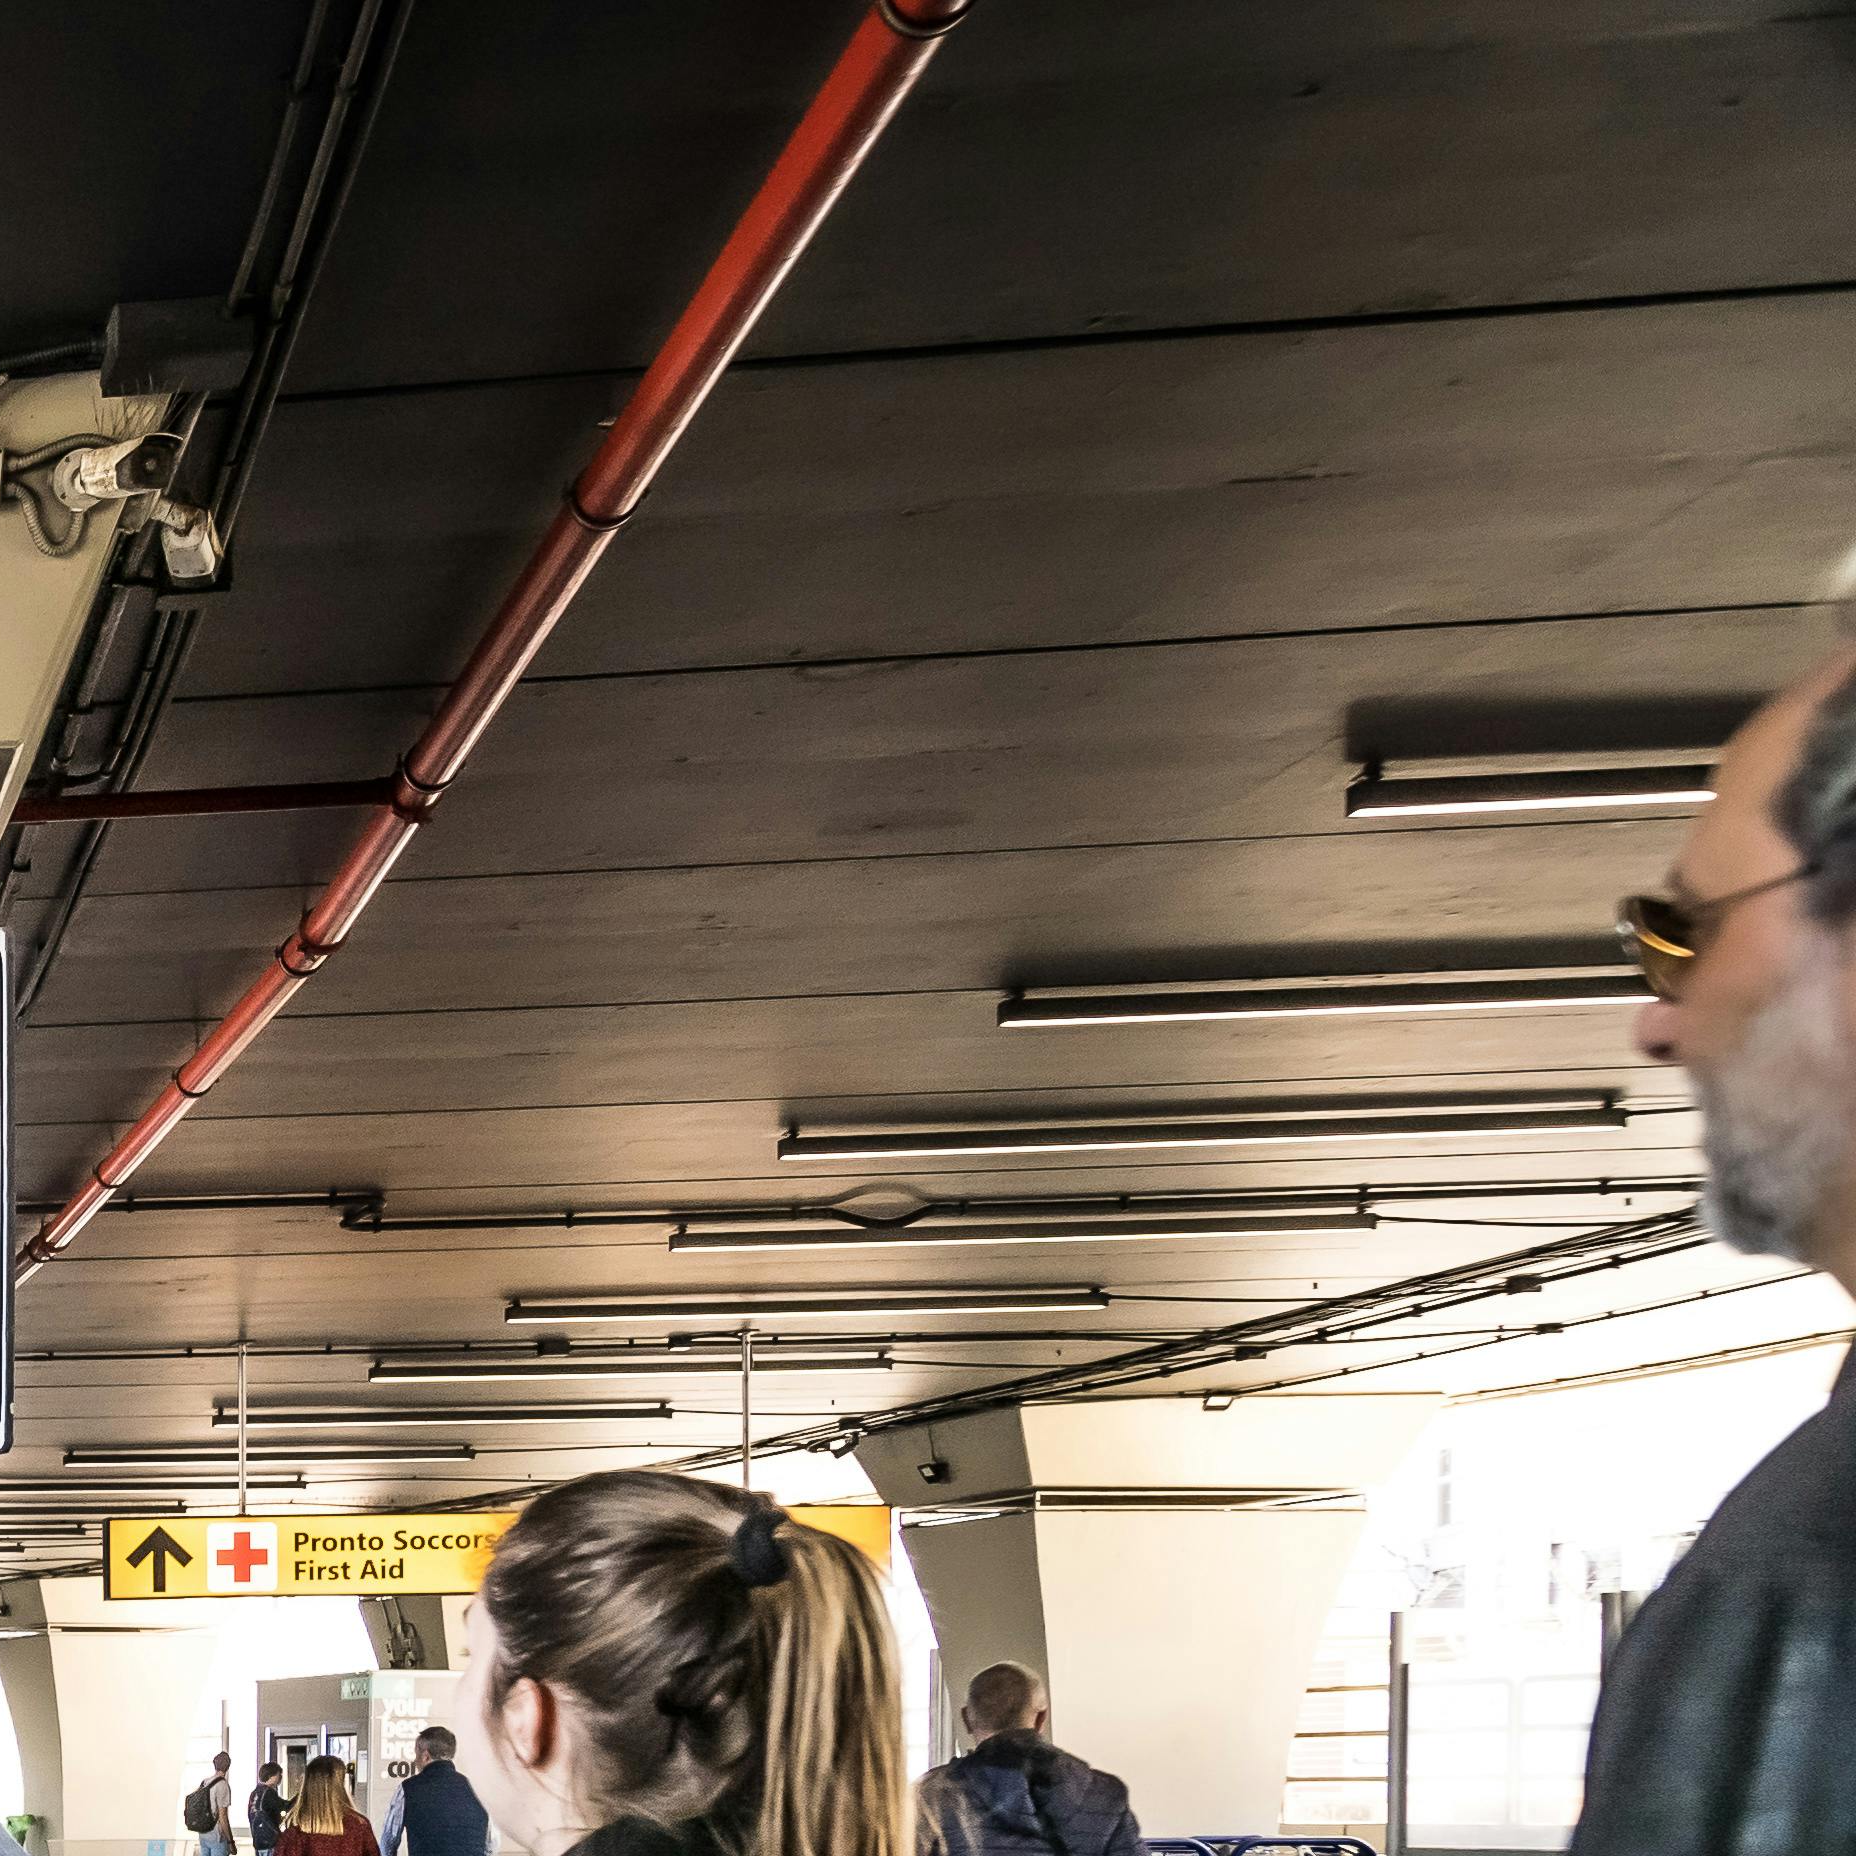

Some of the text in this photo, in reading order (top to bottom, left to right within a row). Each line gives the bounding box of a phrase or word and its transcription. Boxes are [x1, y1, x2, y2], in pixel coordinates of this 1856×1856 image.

[294, 1532, 384, 1552] Pronto
[294, 1558, 404, 1581] First Aid
